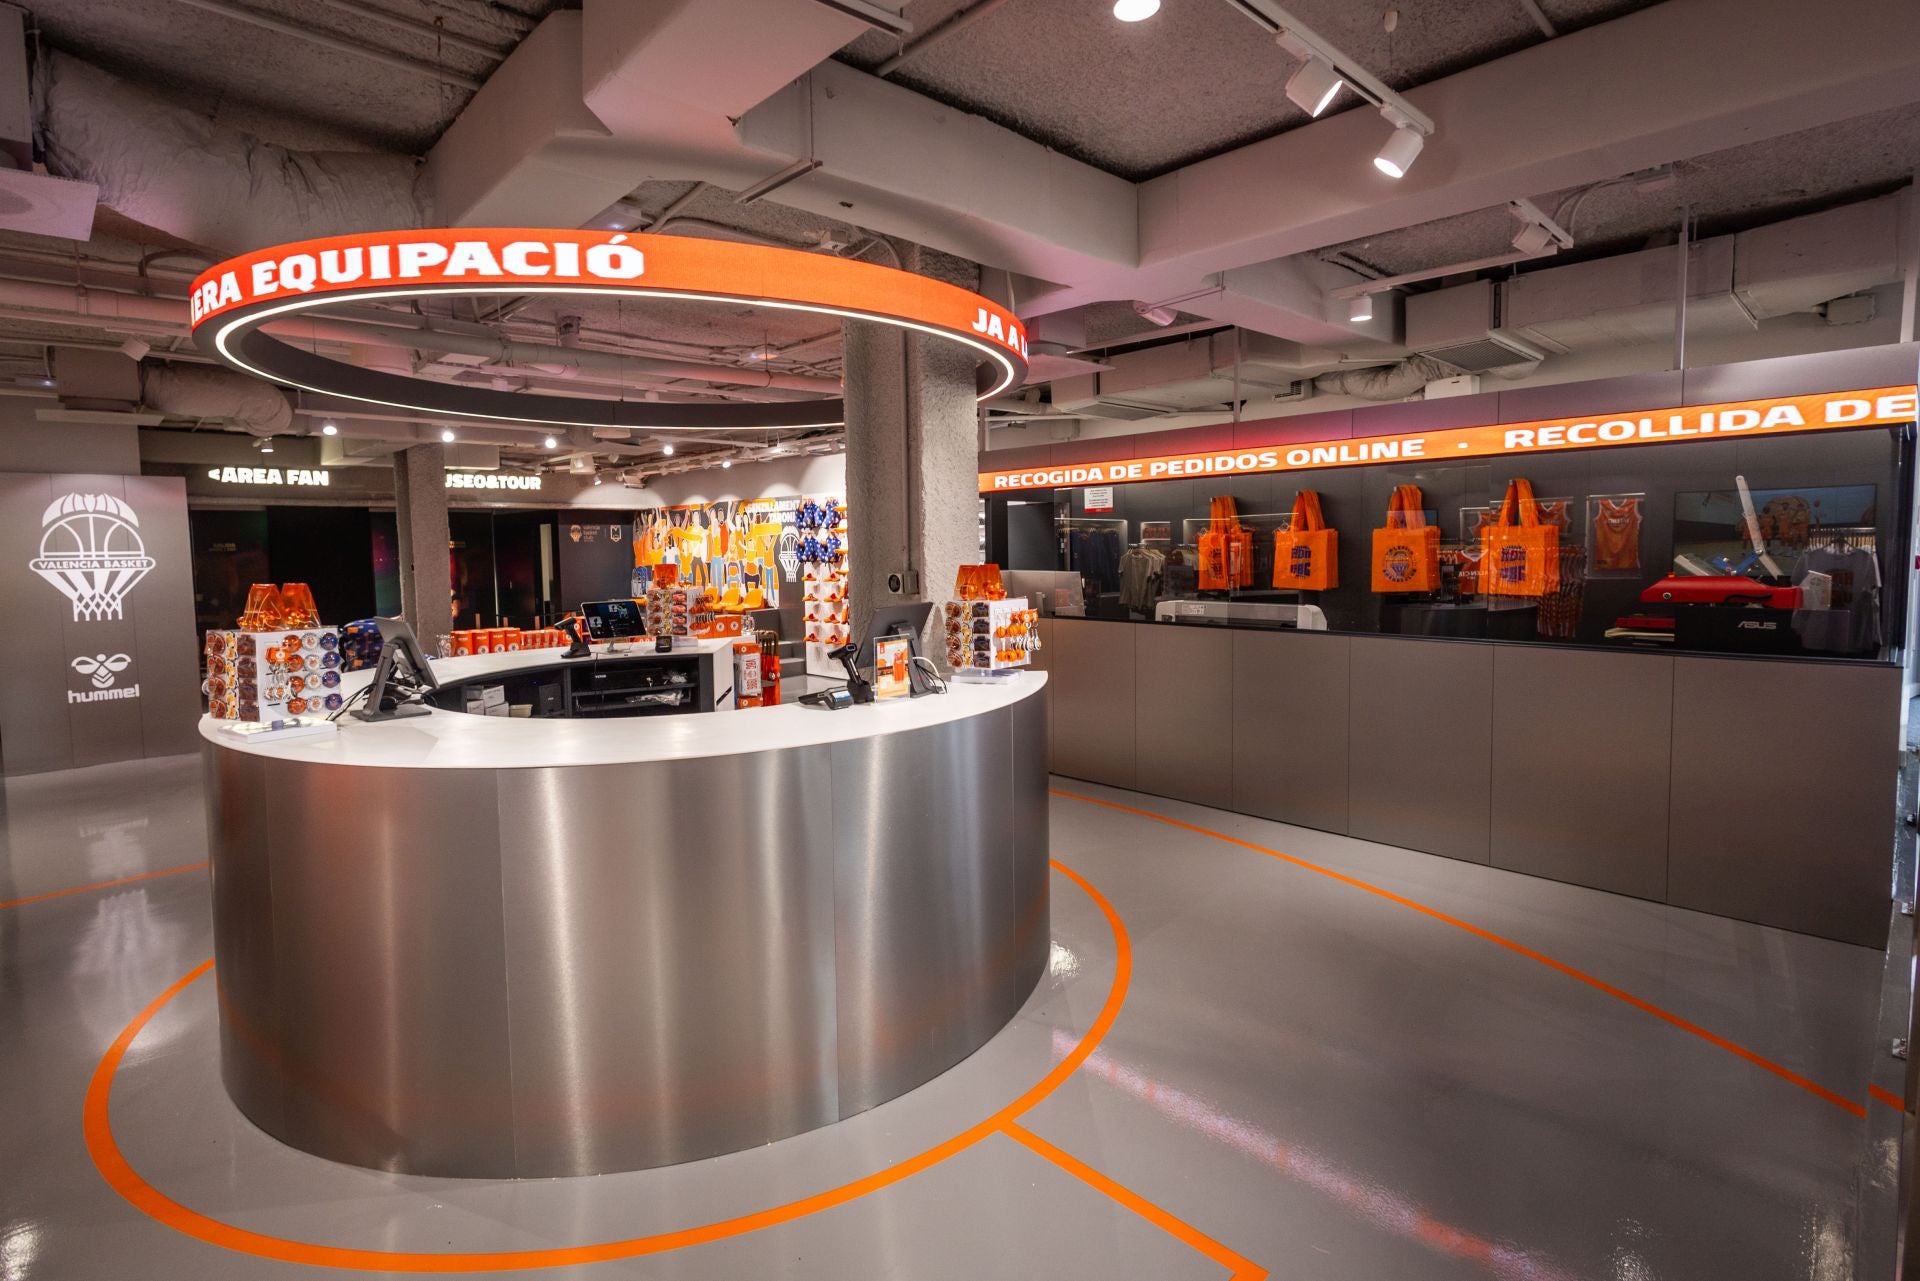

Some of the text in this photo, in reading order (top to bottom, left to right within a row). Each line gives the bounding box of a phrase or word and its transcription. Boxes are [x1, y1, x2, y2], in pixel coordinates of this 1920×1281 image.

[252, 234, 645, 296] EQUIPACIÓ
[972, 308, 1004, 342] JA
[994, 394, 1917, 488] RECOGIDA DE PEDIDOS ONLINE RECOLLIDA DE
[221, 467, 329, 486] AREA FAN
[39, 559, 148, 569] VALENCIA BASKET
[1738, 621, 1777, 630] ASUS
[67, 684, 140, 704] hummel
